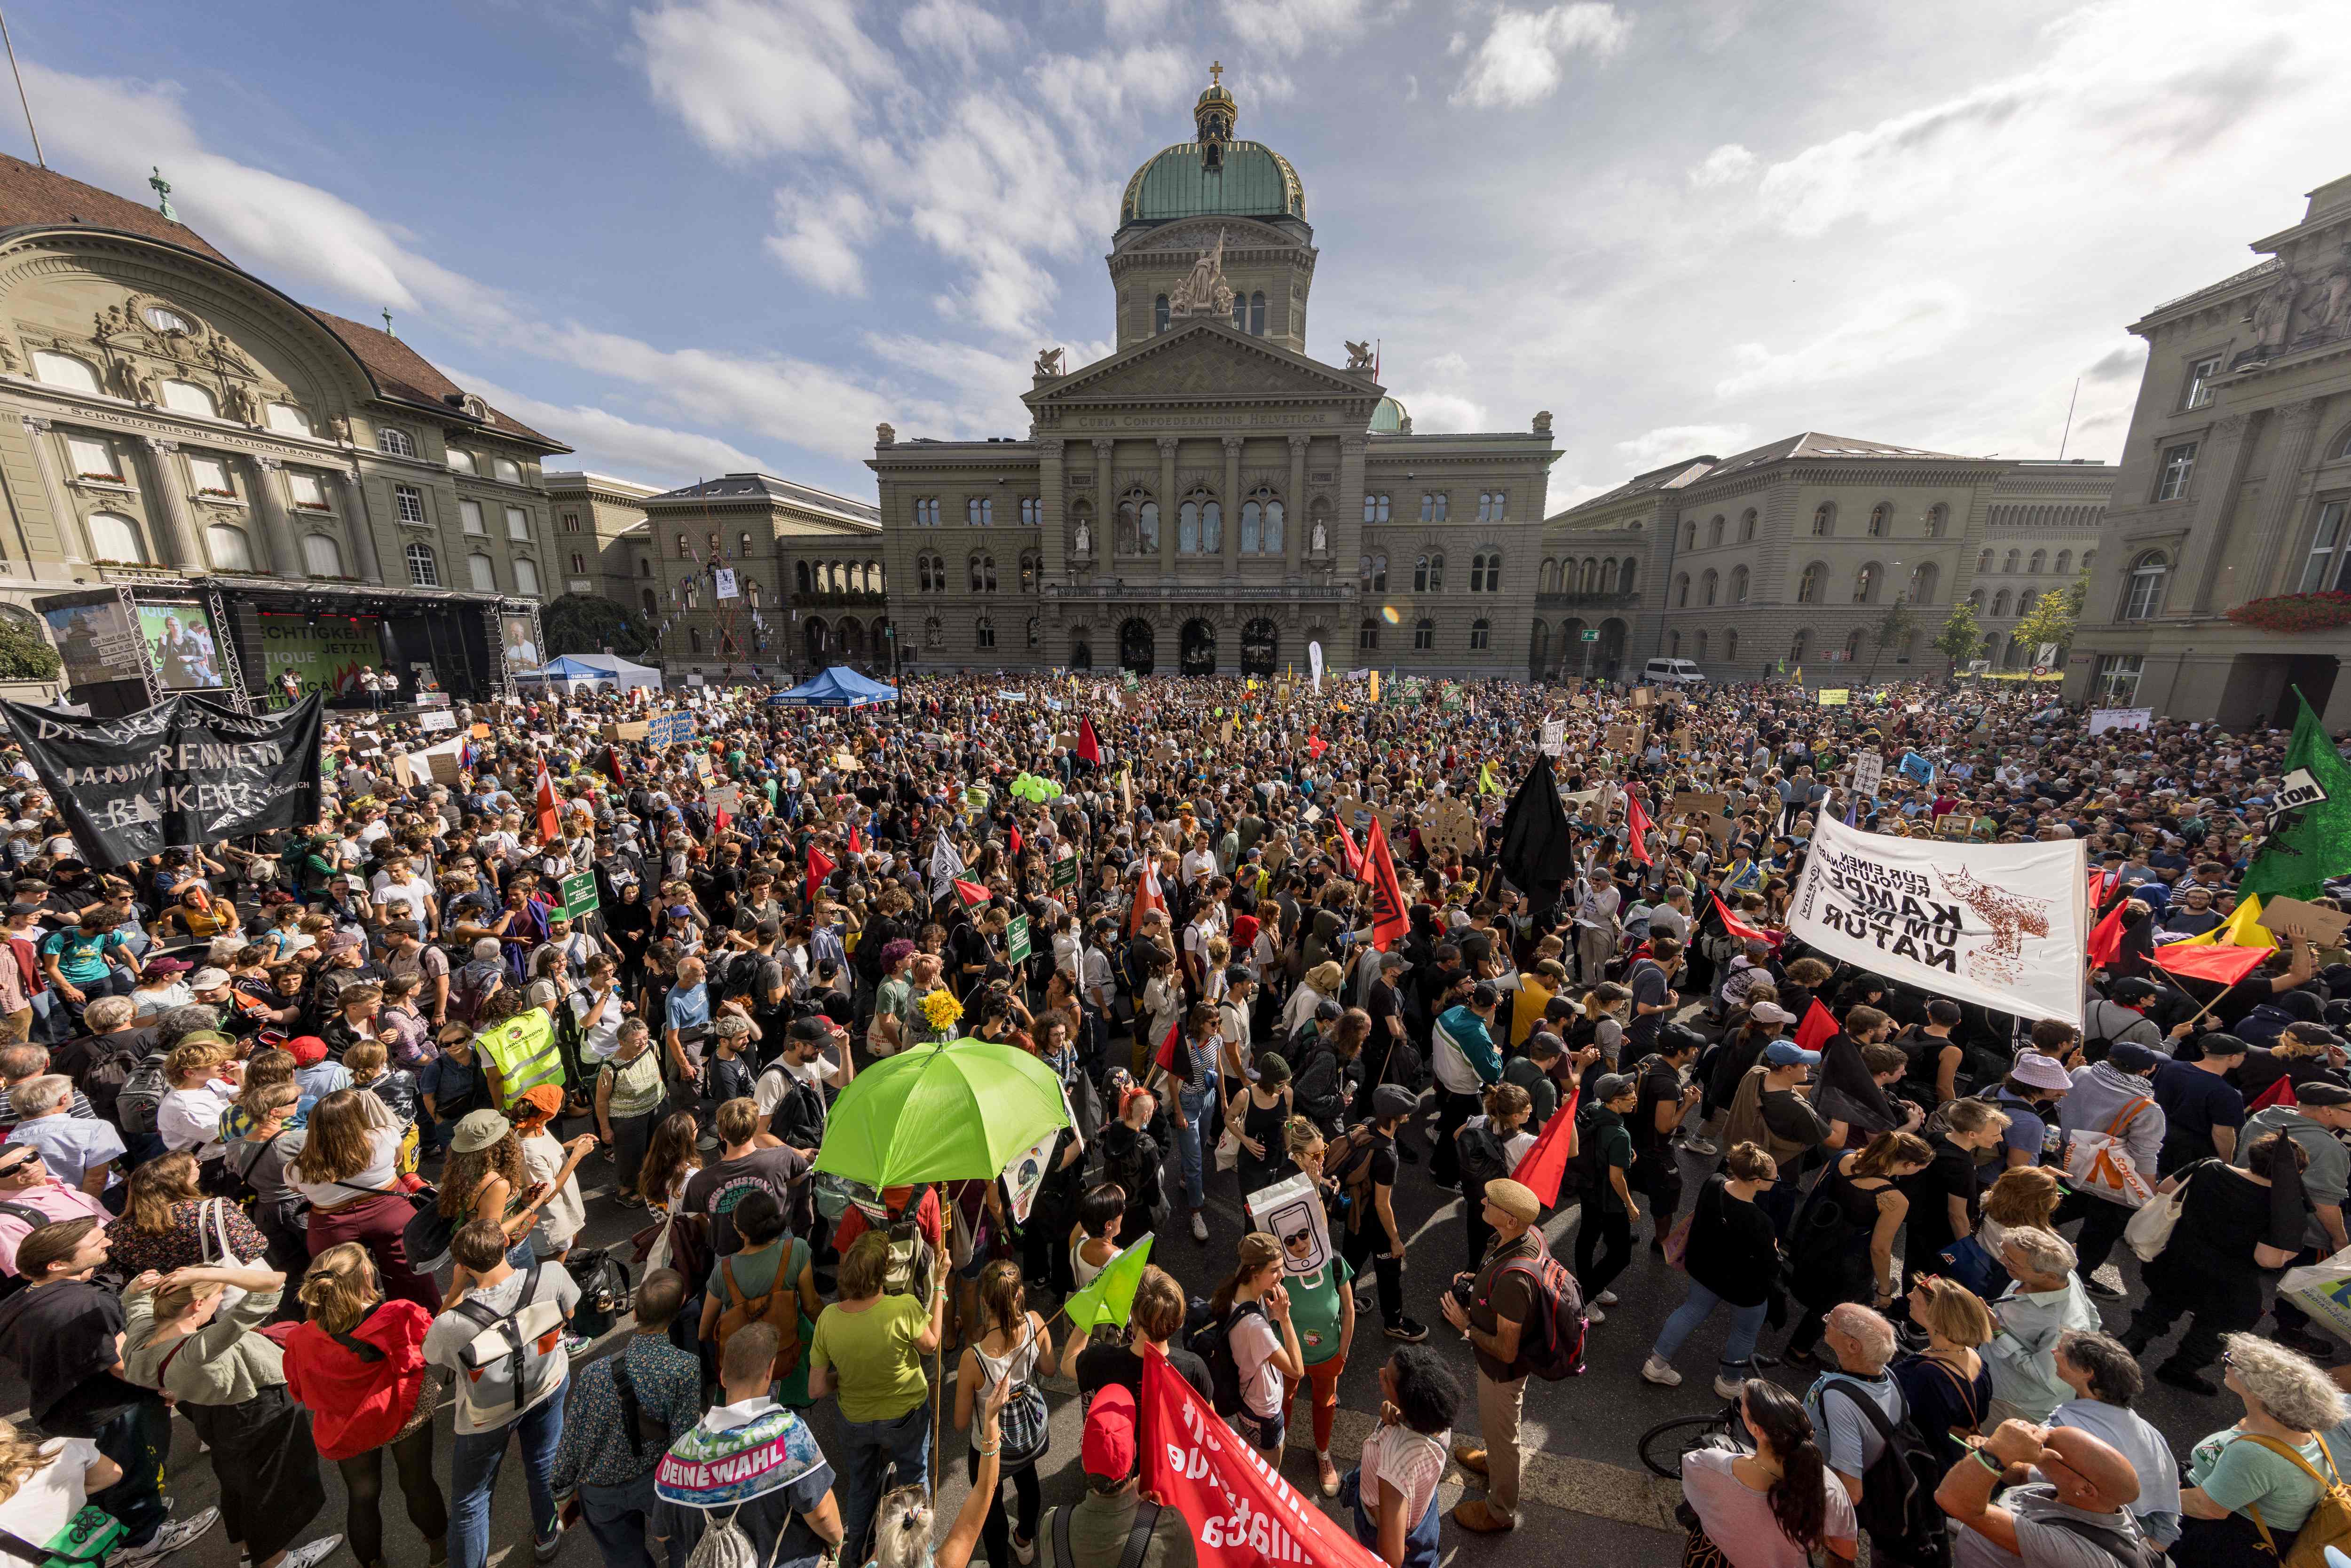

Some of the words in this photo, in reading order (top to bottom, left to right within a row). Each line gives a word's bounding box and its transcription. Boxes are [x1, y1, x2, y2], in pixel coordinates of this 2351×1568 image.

[103, 635, 116, 645] hast
[117, 632, 126, 641] die
[323, 643, 374, 654] JETZT!
[1861, 762, 1877, 773] Earth
[1855, 779, 1861, 788] of
[1861, 782, 1876, 793] herself
[1057, 865, 1073, 874] PEOPLE
[1057, 871, 1073, 881] PROFIT!
[569, 884, 592, 897] REVOLUTION
[569, 893, 595, 906] KATASTROPHE
[1011, 927, 1026, 938] KLIMAKRISE
[1011, 936, 1028, 949] KAPITALISMUS
[505, 1027, 544, 1051] peacekeeping
[2113, 1156, 2146, 1200] MIGROS
[1011, 1173, 1040, 1204] KLIMASCHUTZ
[866, 1200, 883, 1211] KLIMA
[868, 1208, 884, 1216] WAHL
[2306, 1286, 2314, 1295] JE
[2315, 1293, 2333, 1307] VAIS
[661, 1458, 710, 1488] DEINE
[711, 1442, 784, 1484] WAHL
